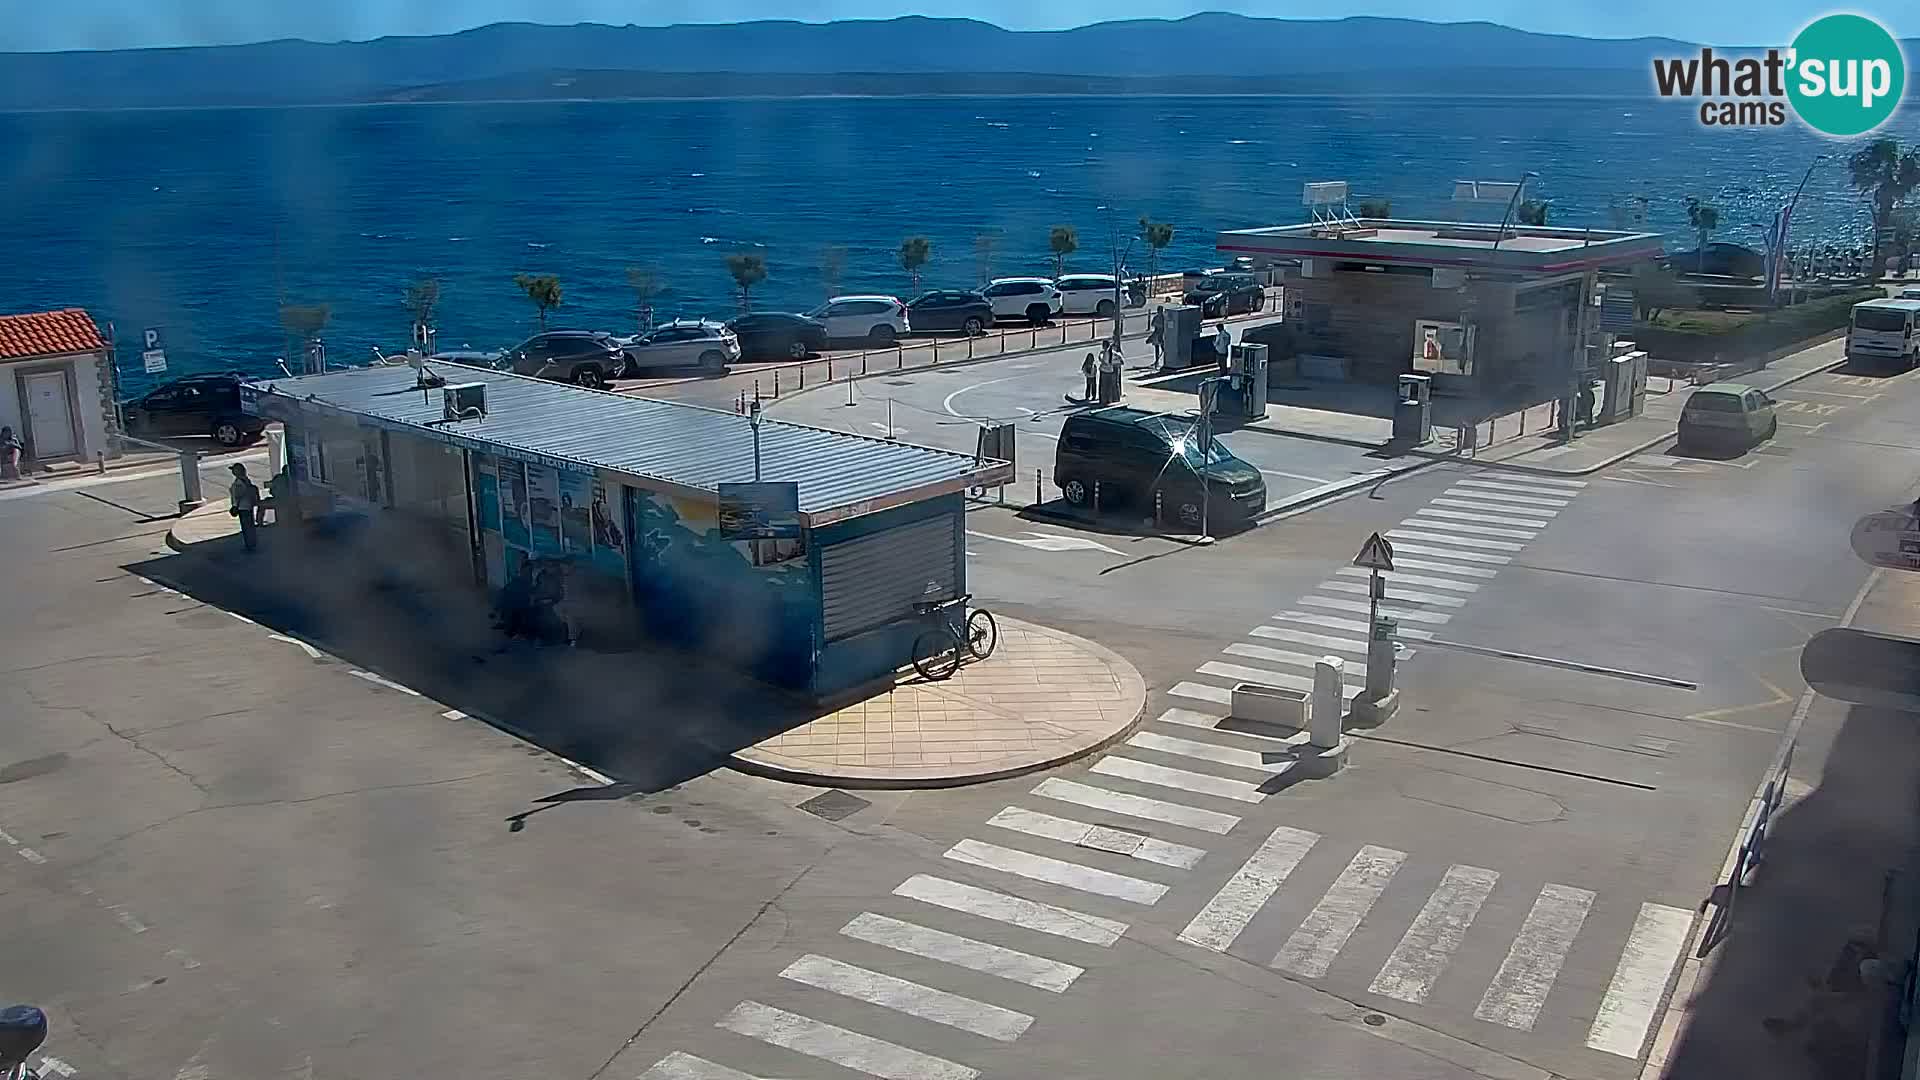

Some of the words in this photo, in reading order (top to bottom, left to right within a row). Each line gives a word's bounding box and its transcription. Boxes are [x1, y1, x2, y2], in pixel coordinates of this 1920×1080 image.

[145, 331, 157, 348] P
[508, 449, 540, 463] STATION
[541, 457, 567, 469] TICKET
[567, 464, 594, 476] OFFICE
